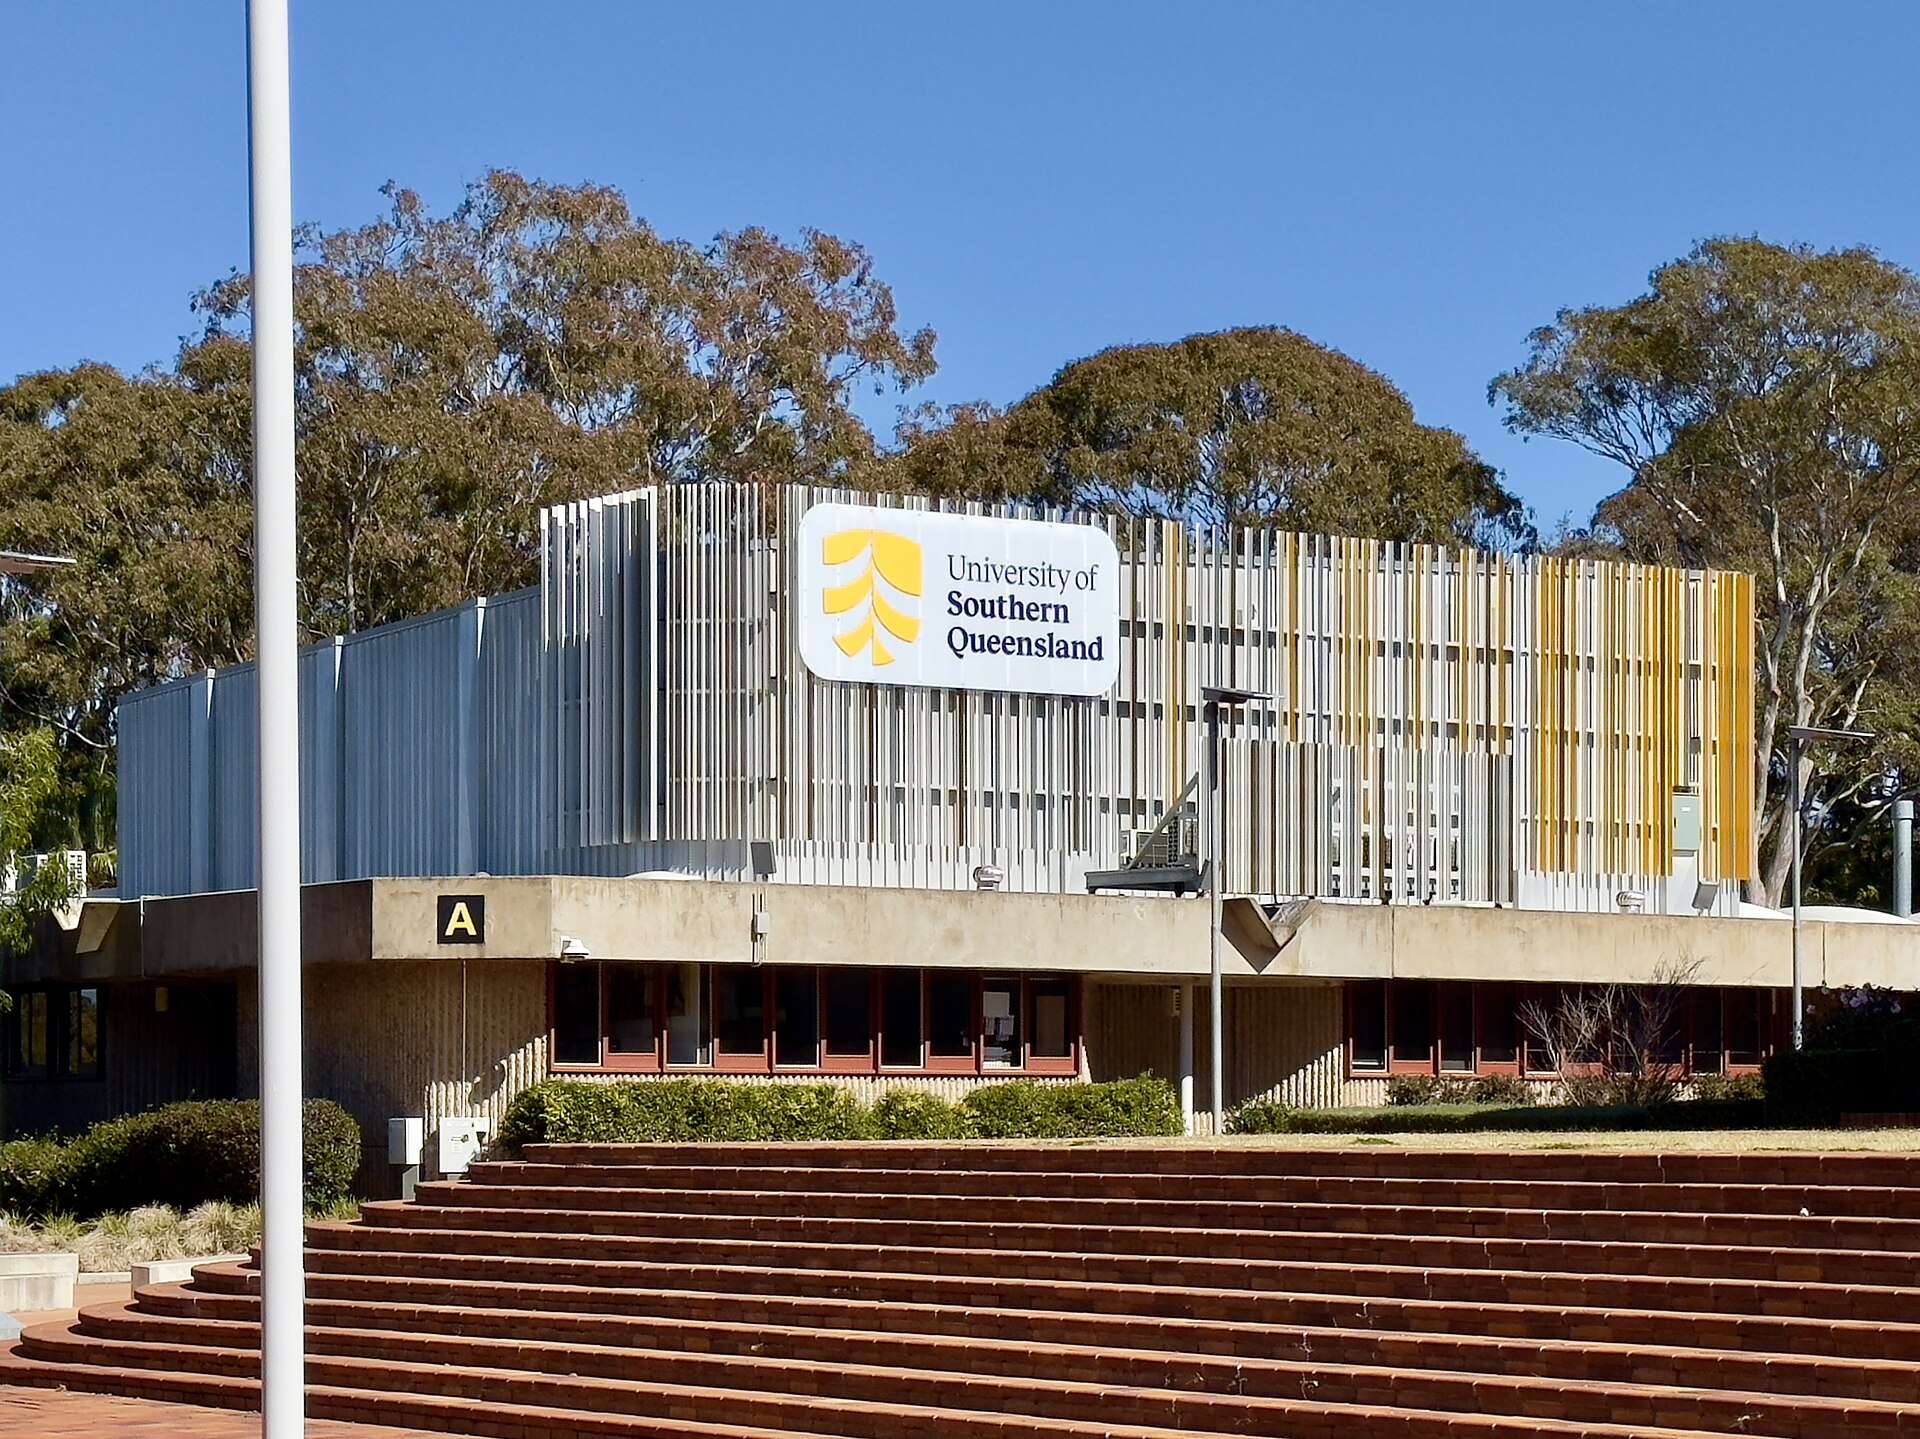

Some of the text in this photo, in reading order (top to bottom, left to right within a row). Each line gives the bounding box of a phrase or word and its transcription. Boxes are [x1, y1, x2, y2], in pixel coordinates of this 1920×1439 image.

[948, 554, 1099, 594] University of
[947, 590, 1069, 623] Southern
[947, 626, 1103, 661] Queensland
[444, 902, 477, 936] A
